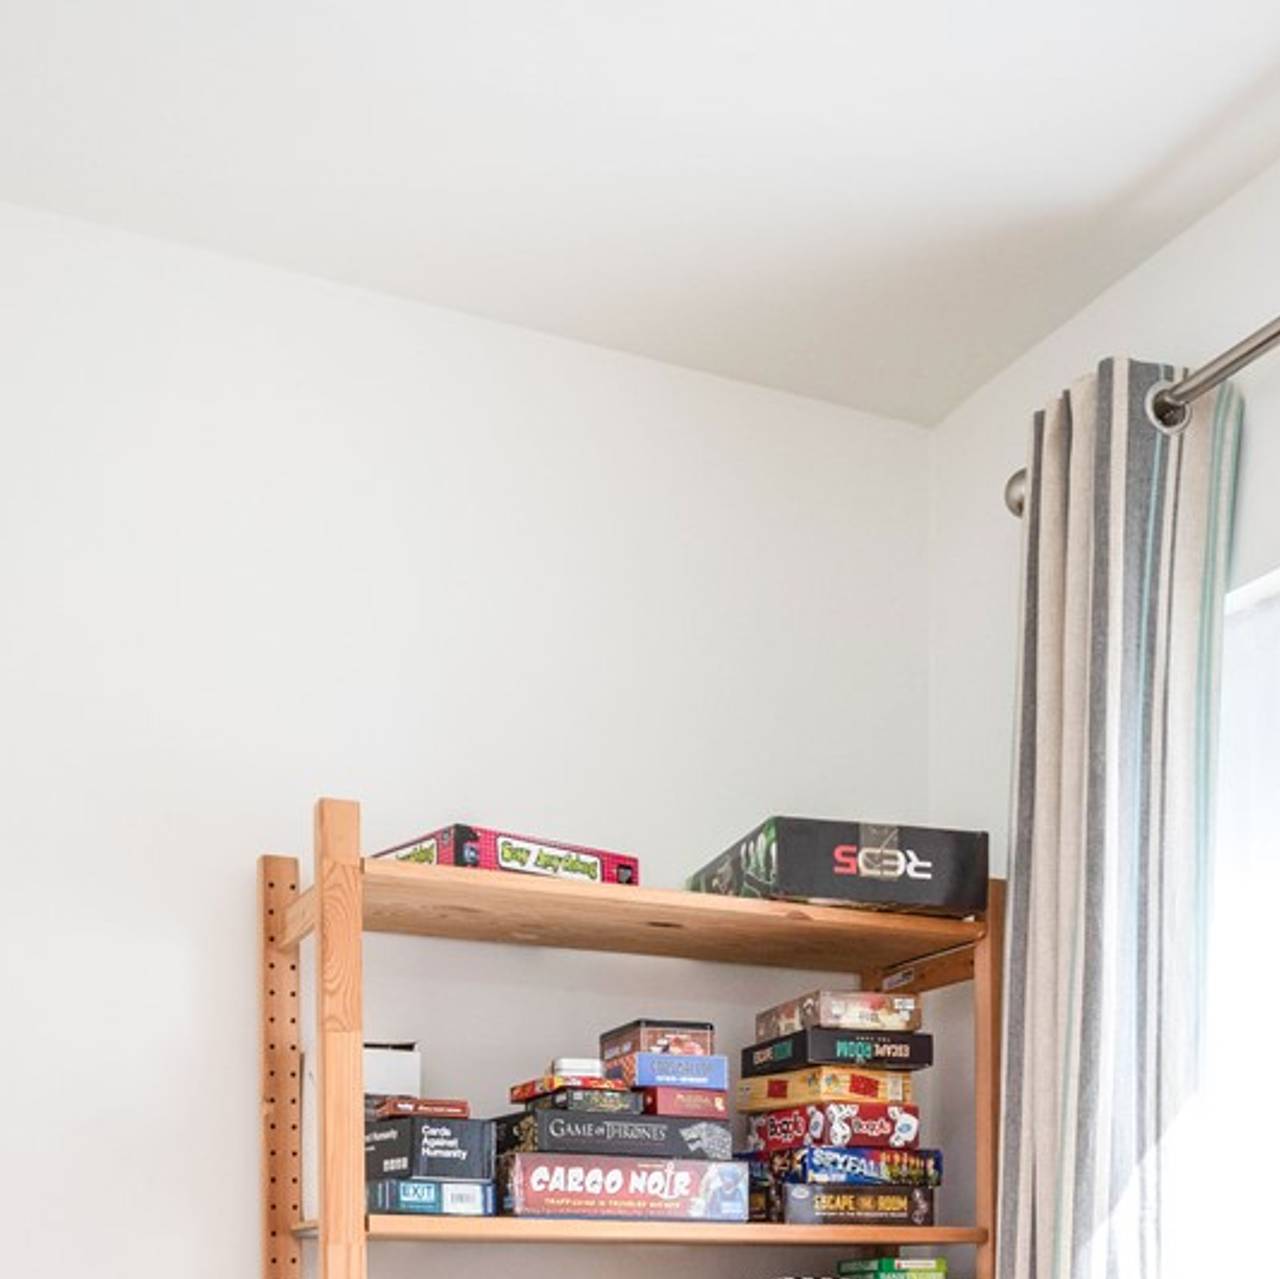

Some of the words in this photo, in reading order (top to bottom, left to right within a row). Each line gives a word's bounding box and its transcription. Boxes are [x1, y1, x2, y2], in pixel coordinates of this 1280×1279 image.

[421, 1125, 451, 1136] Cards
[549, 1118, 595, 1137] GAME
[604, 1121, 669, 1140] THRONES
[422, 1135, 458, 1149] Against
[422, 1148, 468, 1160] Humanity
[813, 1148, 890, 1180] SPYFALL
[530, 1166, 624, 1194] CARGO
[629, 1162, 692, 1199] NOIR
[402, 1184, 433, 1197] EXIT
[815, 1194, 855, 1210] ESCAPE
